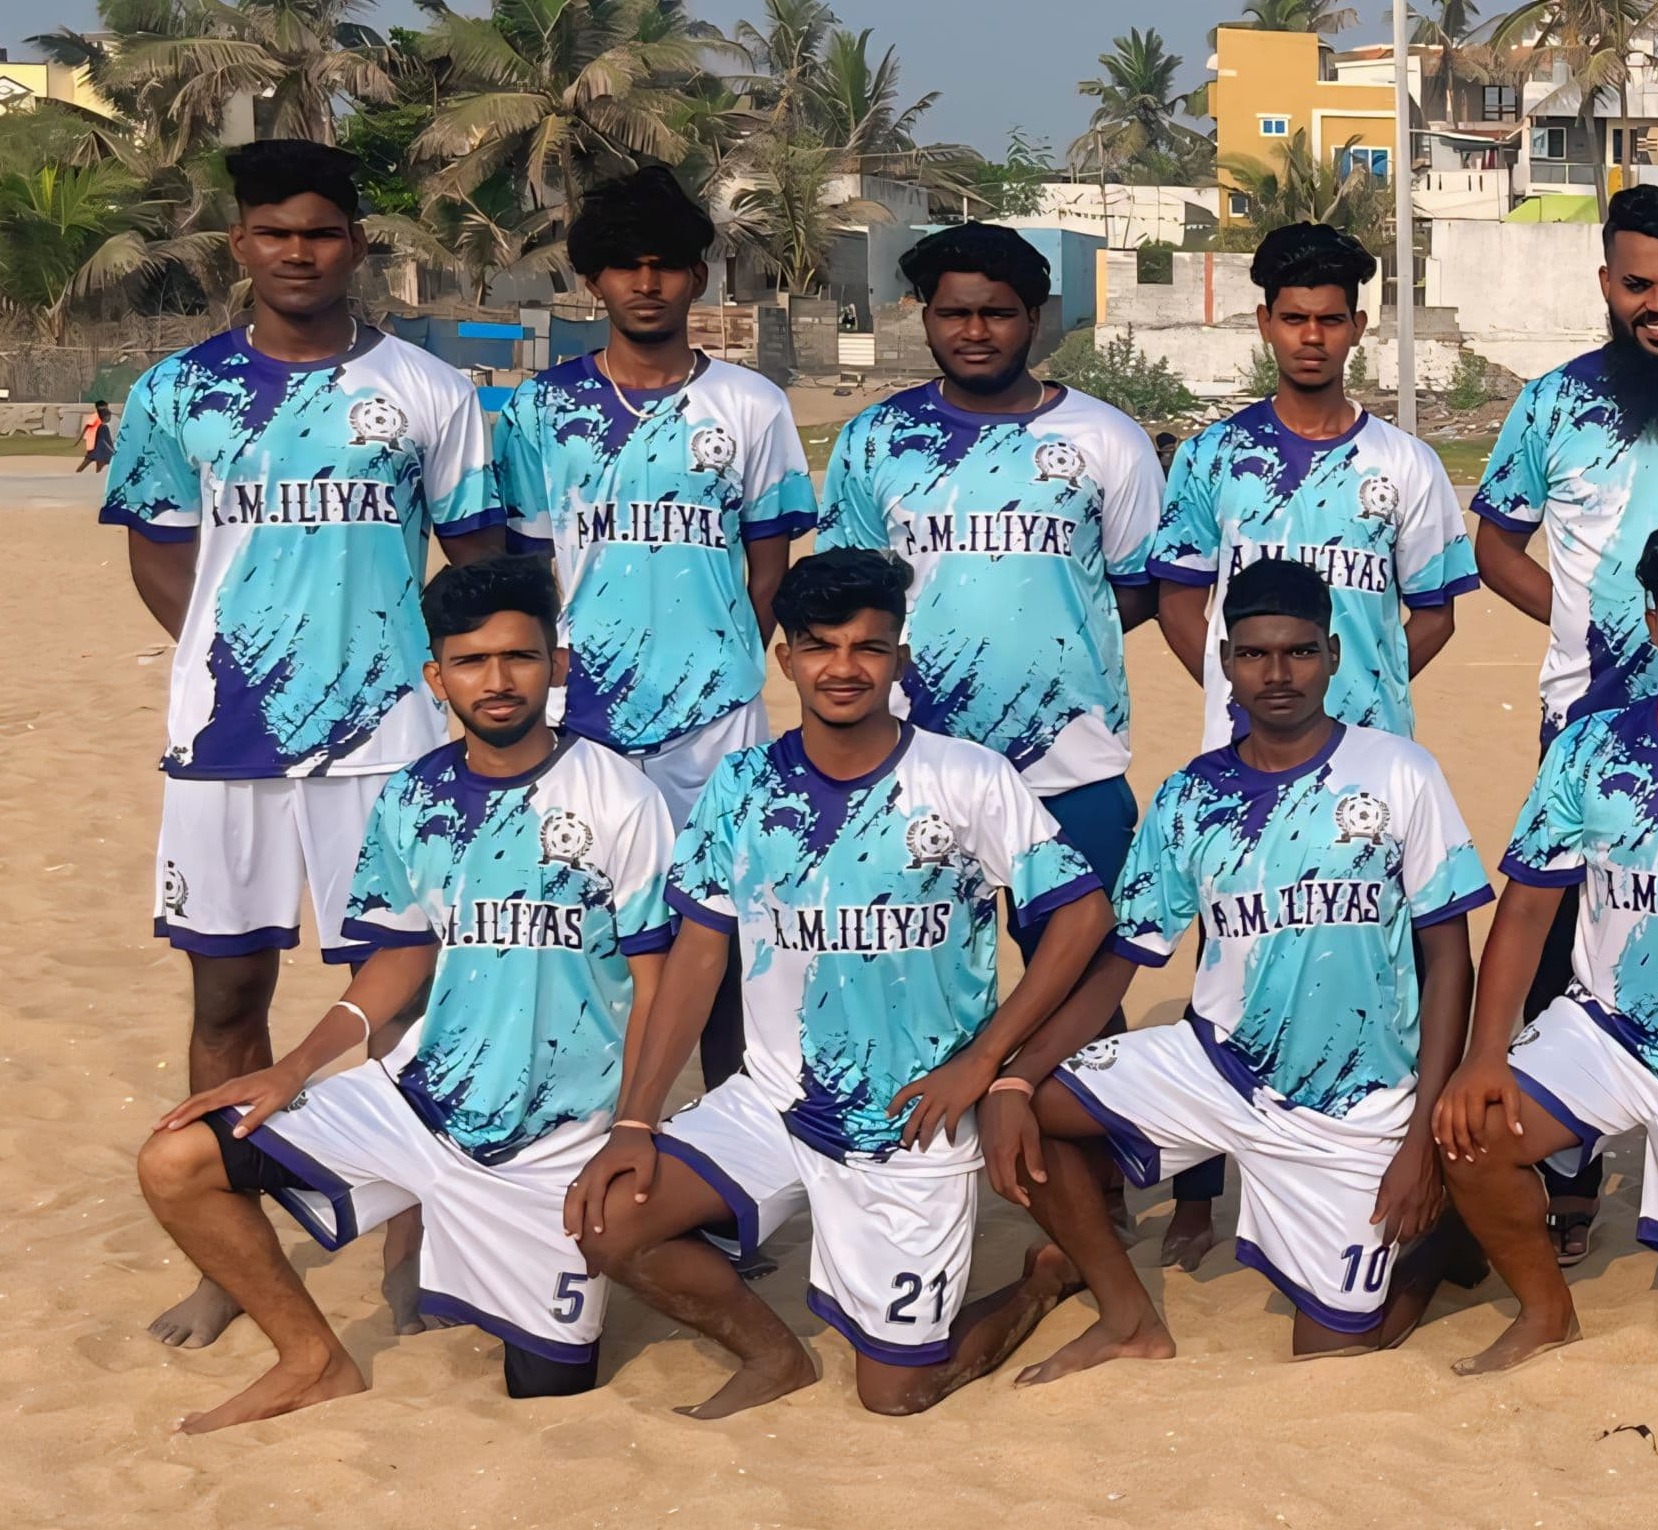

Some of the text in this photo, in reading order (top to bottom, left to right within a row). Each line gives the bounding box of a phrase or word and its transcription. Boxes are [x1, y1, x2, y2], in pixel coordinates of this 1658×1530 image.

[1340, 1244, 1391, 1293] 10
[553, 1271, 588, 1324] 5
[885, 1269, 948, 1325] 21
